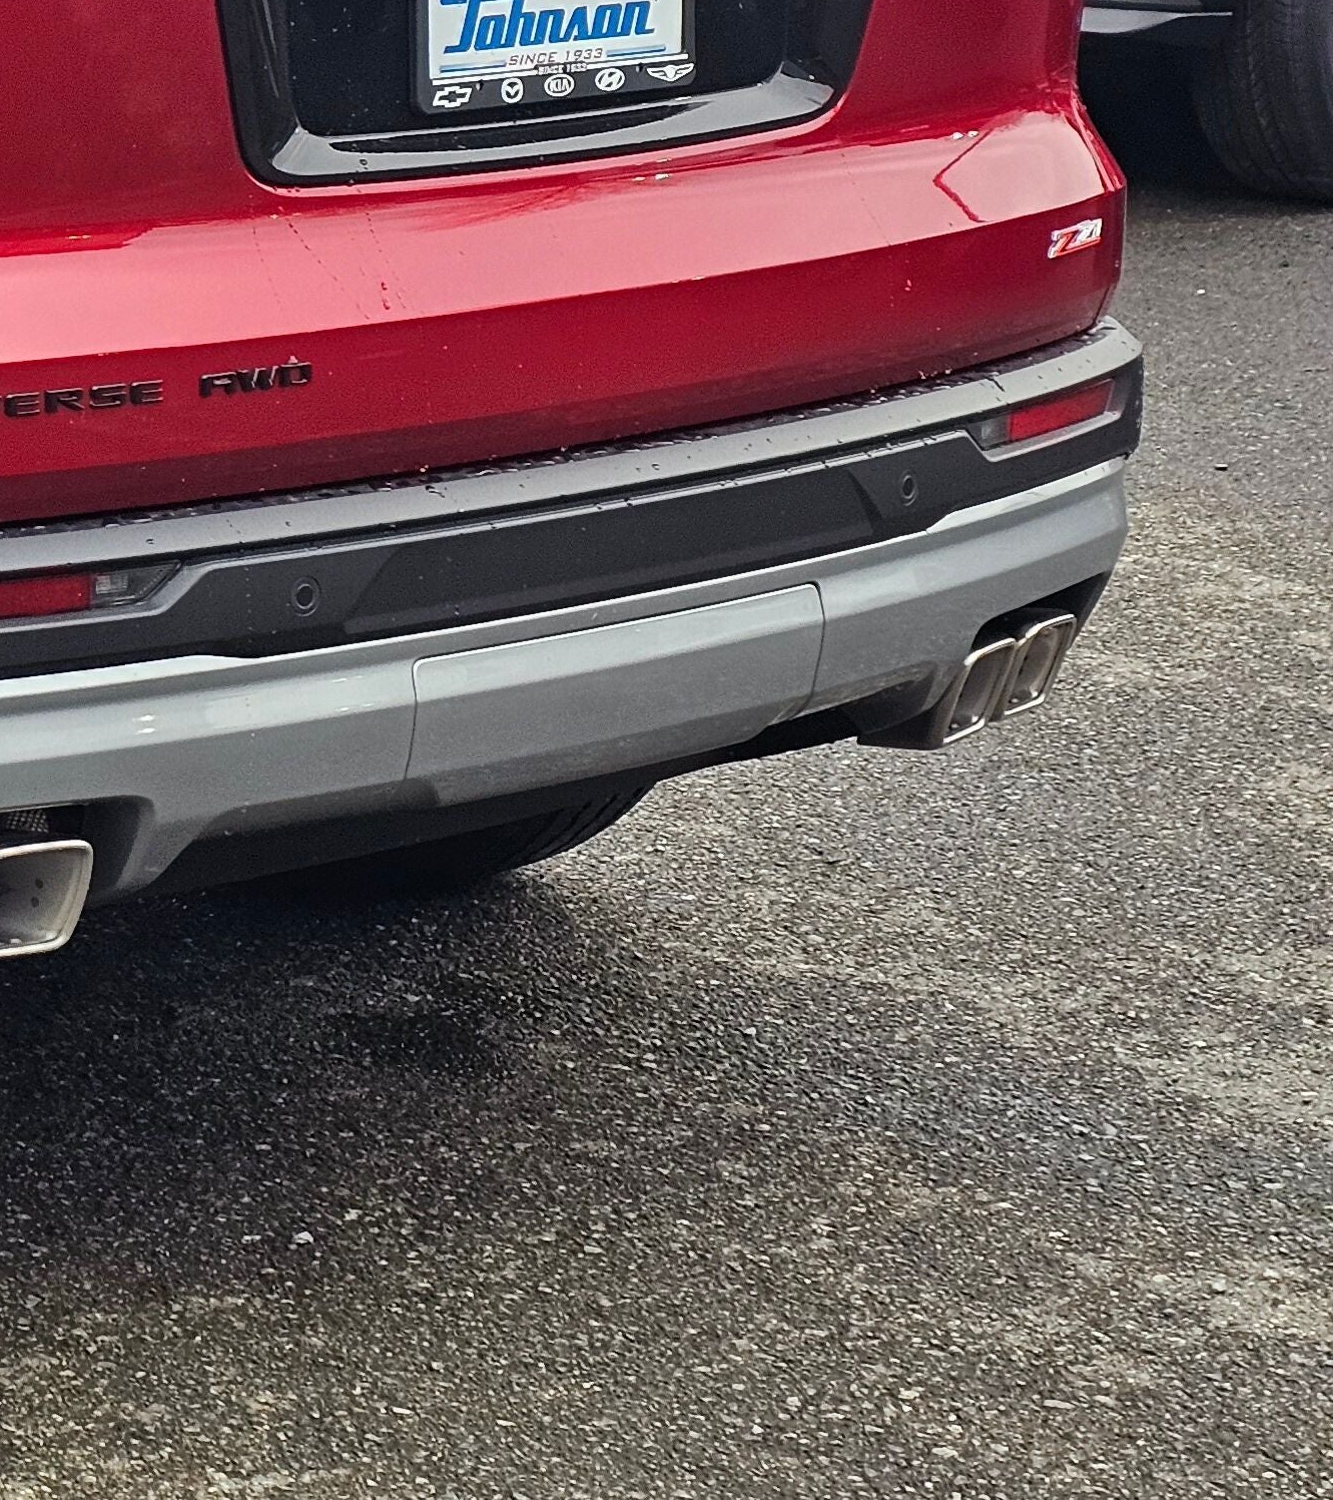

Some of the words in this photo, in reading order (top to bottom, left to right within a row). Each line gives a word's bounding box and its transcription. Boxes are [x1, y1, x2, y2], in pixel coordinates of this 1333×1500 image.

[509, 51, 558, 67] SINCE
[565, 47, 603, 62] 1933
[198, 359, 313, 398] AWD
